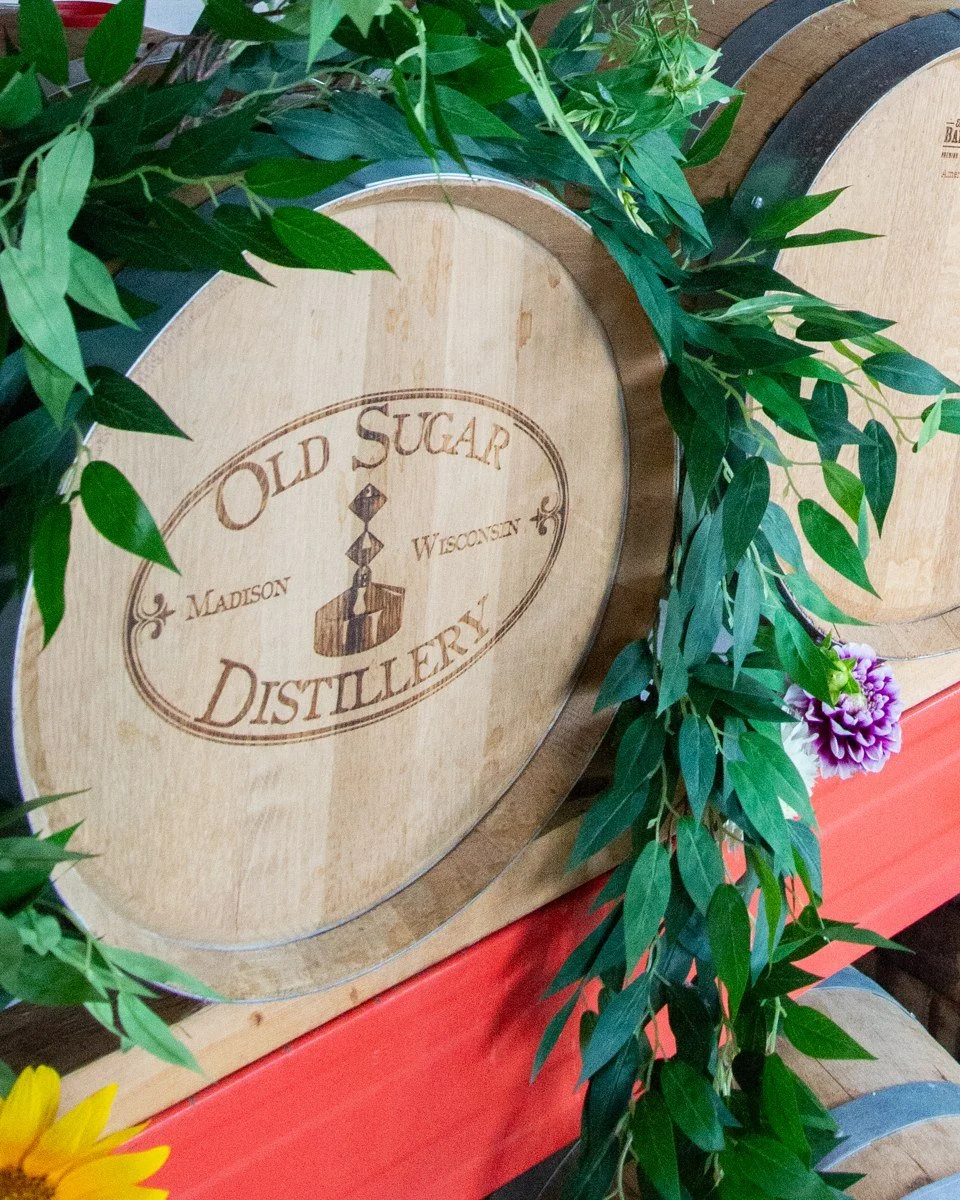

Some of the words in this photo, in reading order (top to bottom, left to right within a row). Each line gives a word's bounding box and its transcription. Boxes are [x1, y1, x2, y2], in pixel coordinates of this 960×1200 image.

[215, 434, 331, 531] OLD
[351, 403, 511, 473] SUGAR
[411, 516, 522, 562] WISCONSIN
[184, 575, 292, 622] MADISON
[193, 592, 491, 729] DISTILLERY
